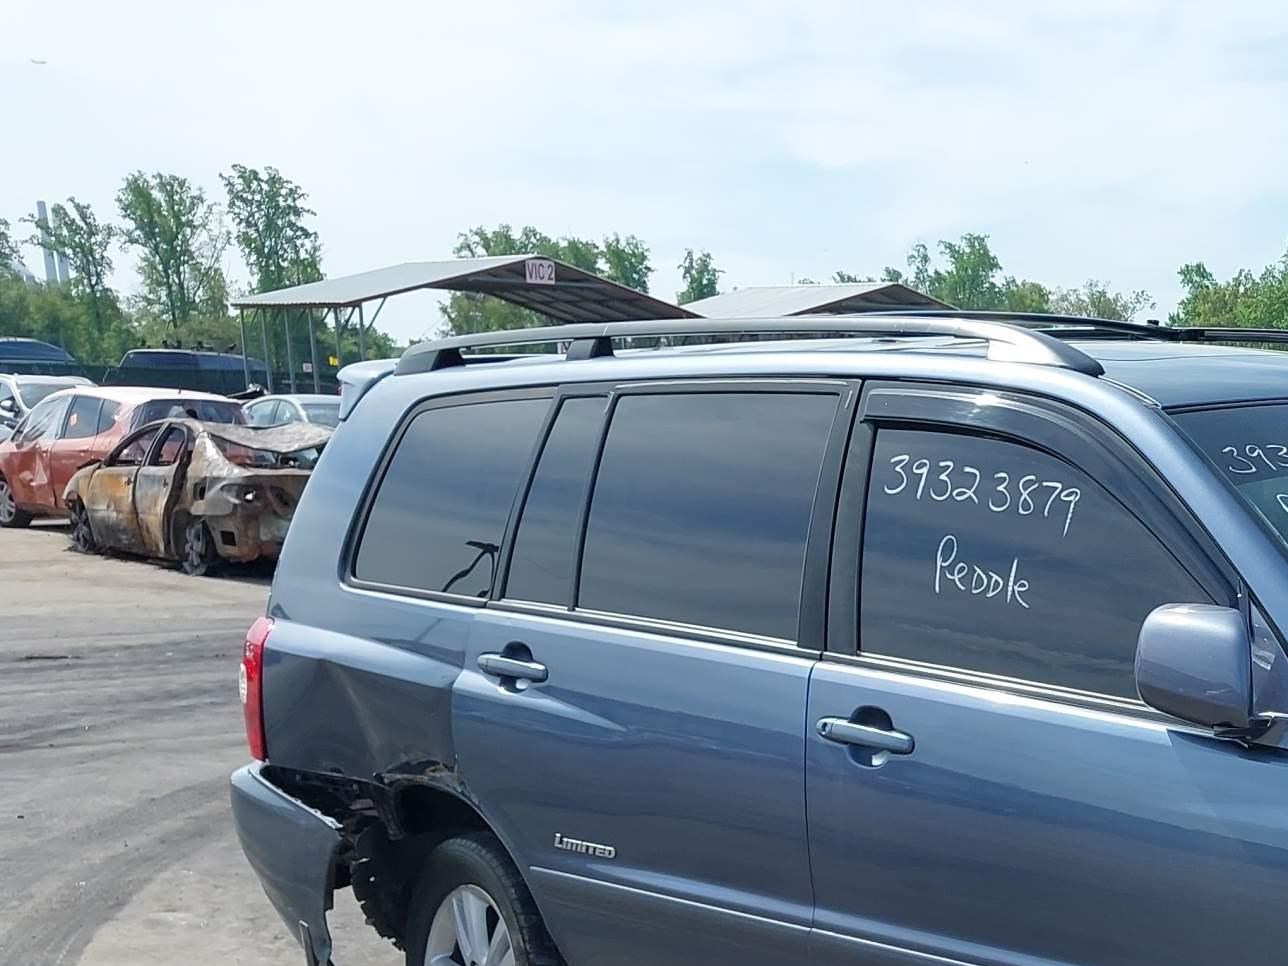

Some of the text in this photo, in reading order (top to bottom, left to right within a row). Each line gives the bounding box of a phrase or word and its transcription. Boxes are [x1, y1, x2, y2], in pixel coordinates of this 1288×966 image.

[527, 263, 554, 281] VIC 2
[883, 454, 1081, 537] 39323879
